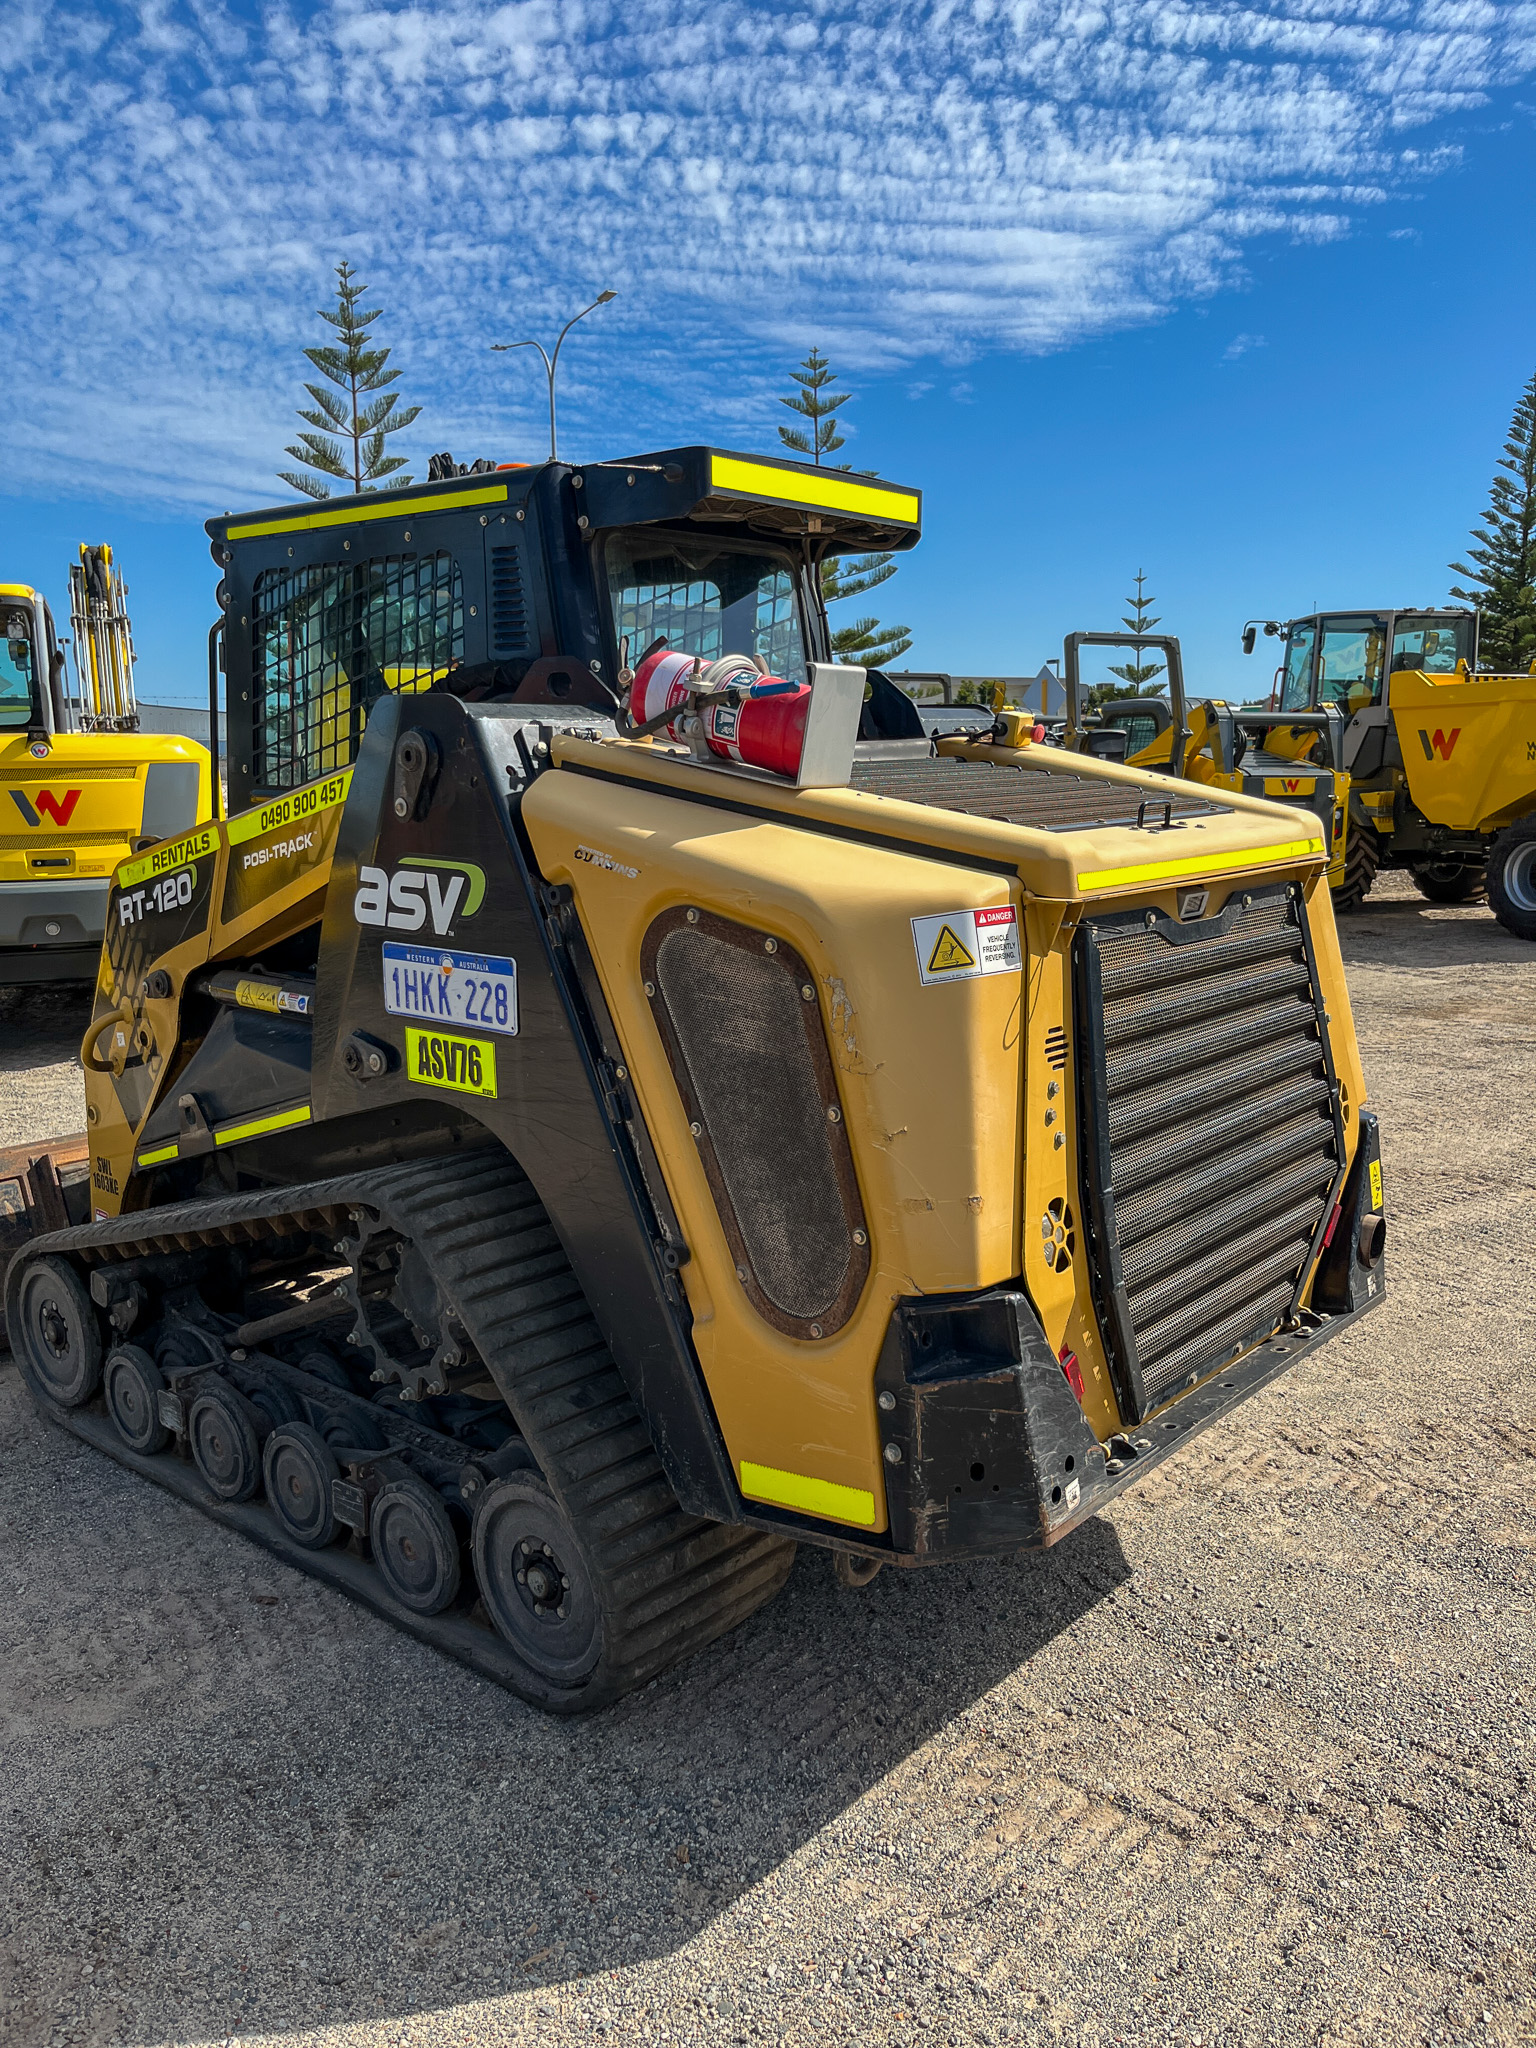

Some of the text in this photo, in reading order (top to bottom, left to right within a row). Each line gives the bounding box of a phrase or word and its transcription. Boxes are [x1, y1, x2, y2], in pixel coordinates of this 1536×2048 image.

[261, 777, 344, 831] 0490 900 457
[152, 833, 210, 872] RENTALS
[243, 833, 313, 869] POSI-TRACK
[574, 849, 639, 879] CUMMINS
[119, 873, 192, 926] RT-120
[987, 911, 1013, 922] DANGER
[982, 941, 1016, 953] FREQUENTLY
[987, 933, 1009, 943] VEHICLE
[406, 953, 489, 972] WESTERN AUSTRALIA
[418, 1035, 483, 1087] ASV76
[96, 1156, 113, 1176] SWL
